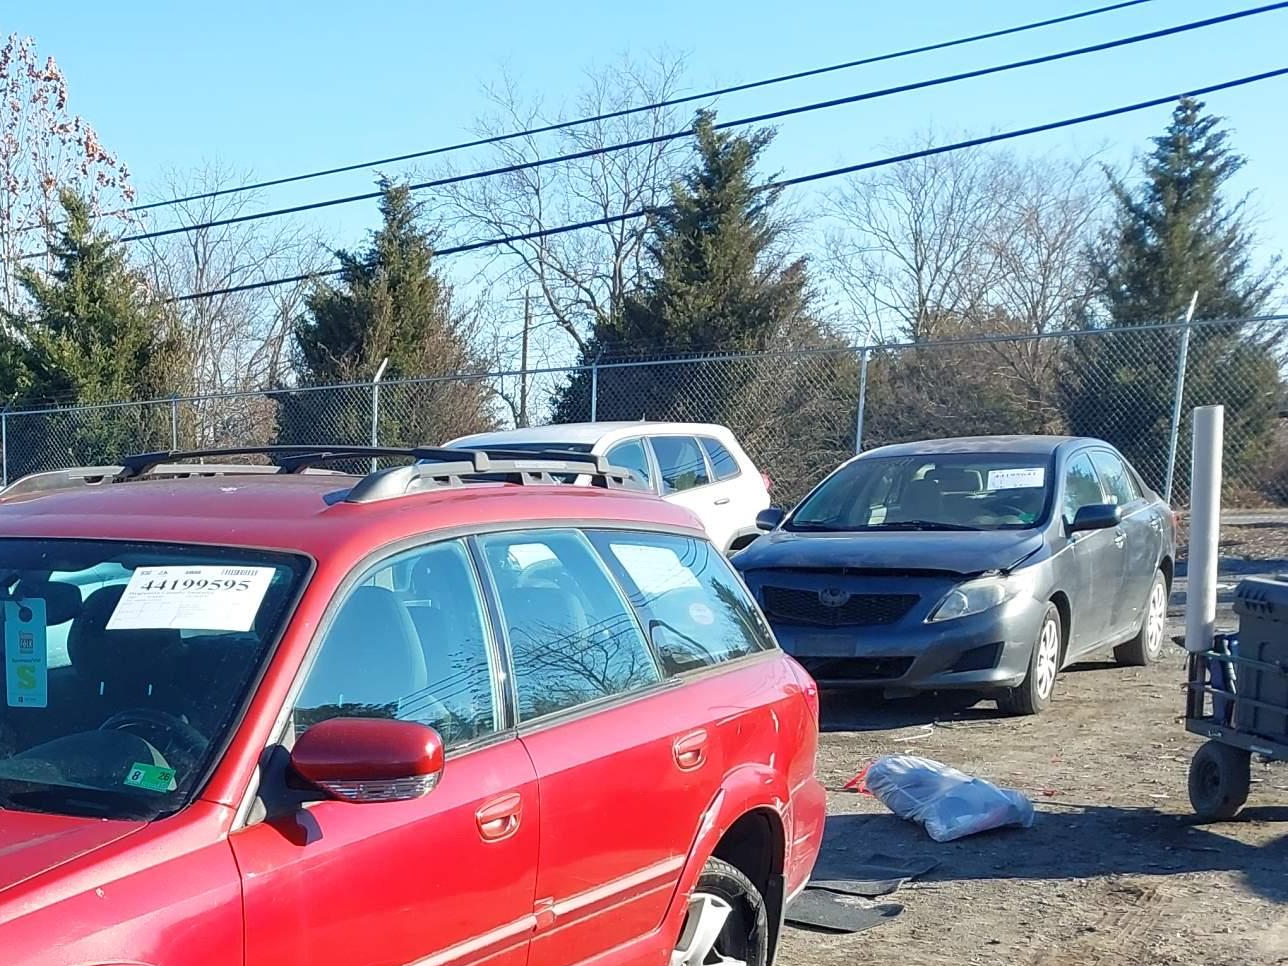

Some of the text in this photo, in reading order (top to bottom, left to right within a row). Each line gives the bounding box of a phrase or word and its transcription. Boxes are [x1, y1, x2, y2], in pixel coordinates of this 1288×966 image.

[140, 579, 252, 592] 44199595
[132, 770, 170, 781] 8 26
